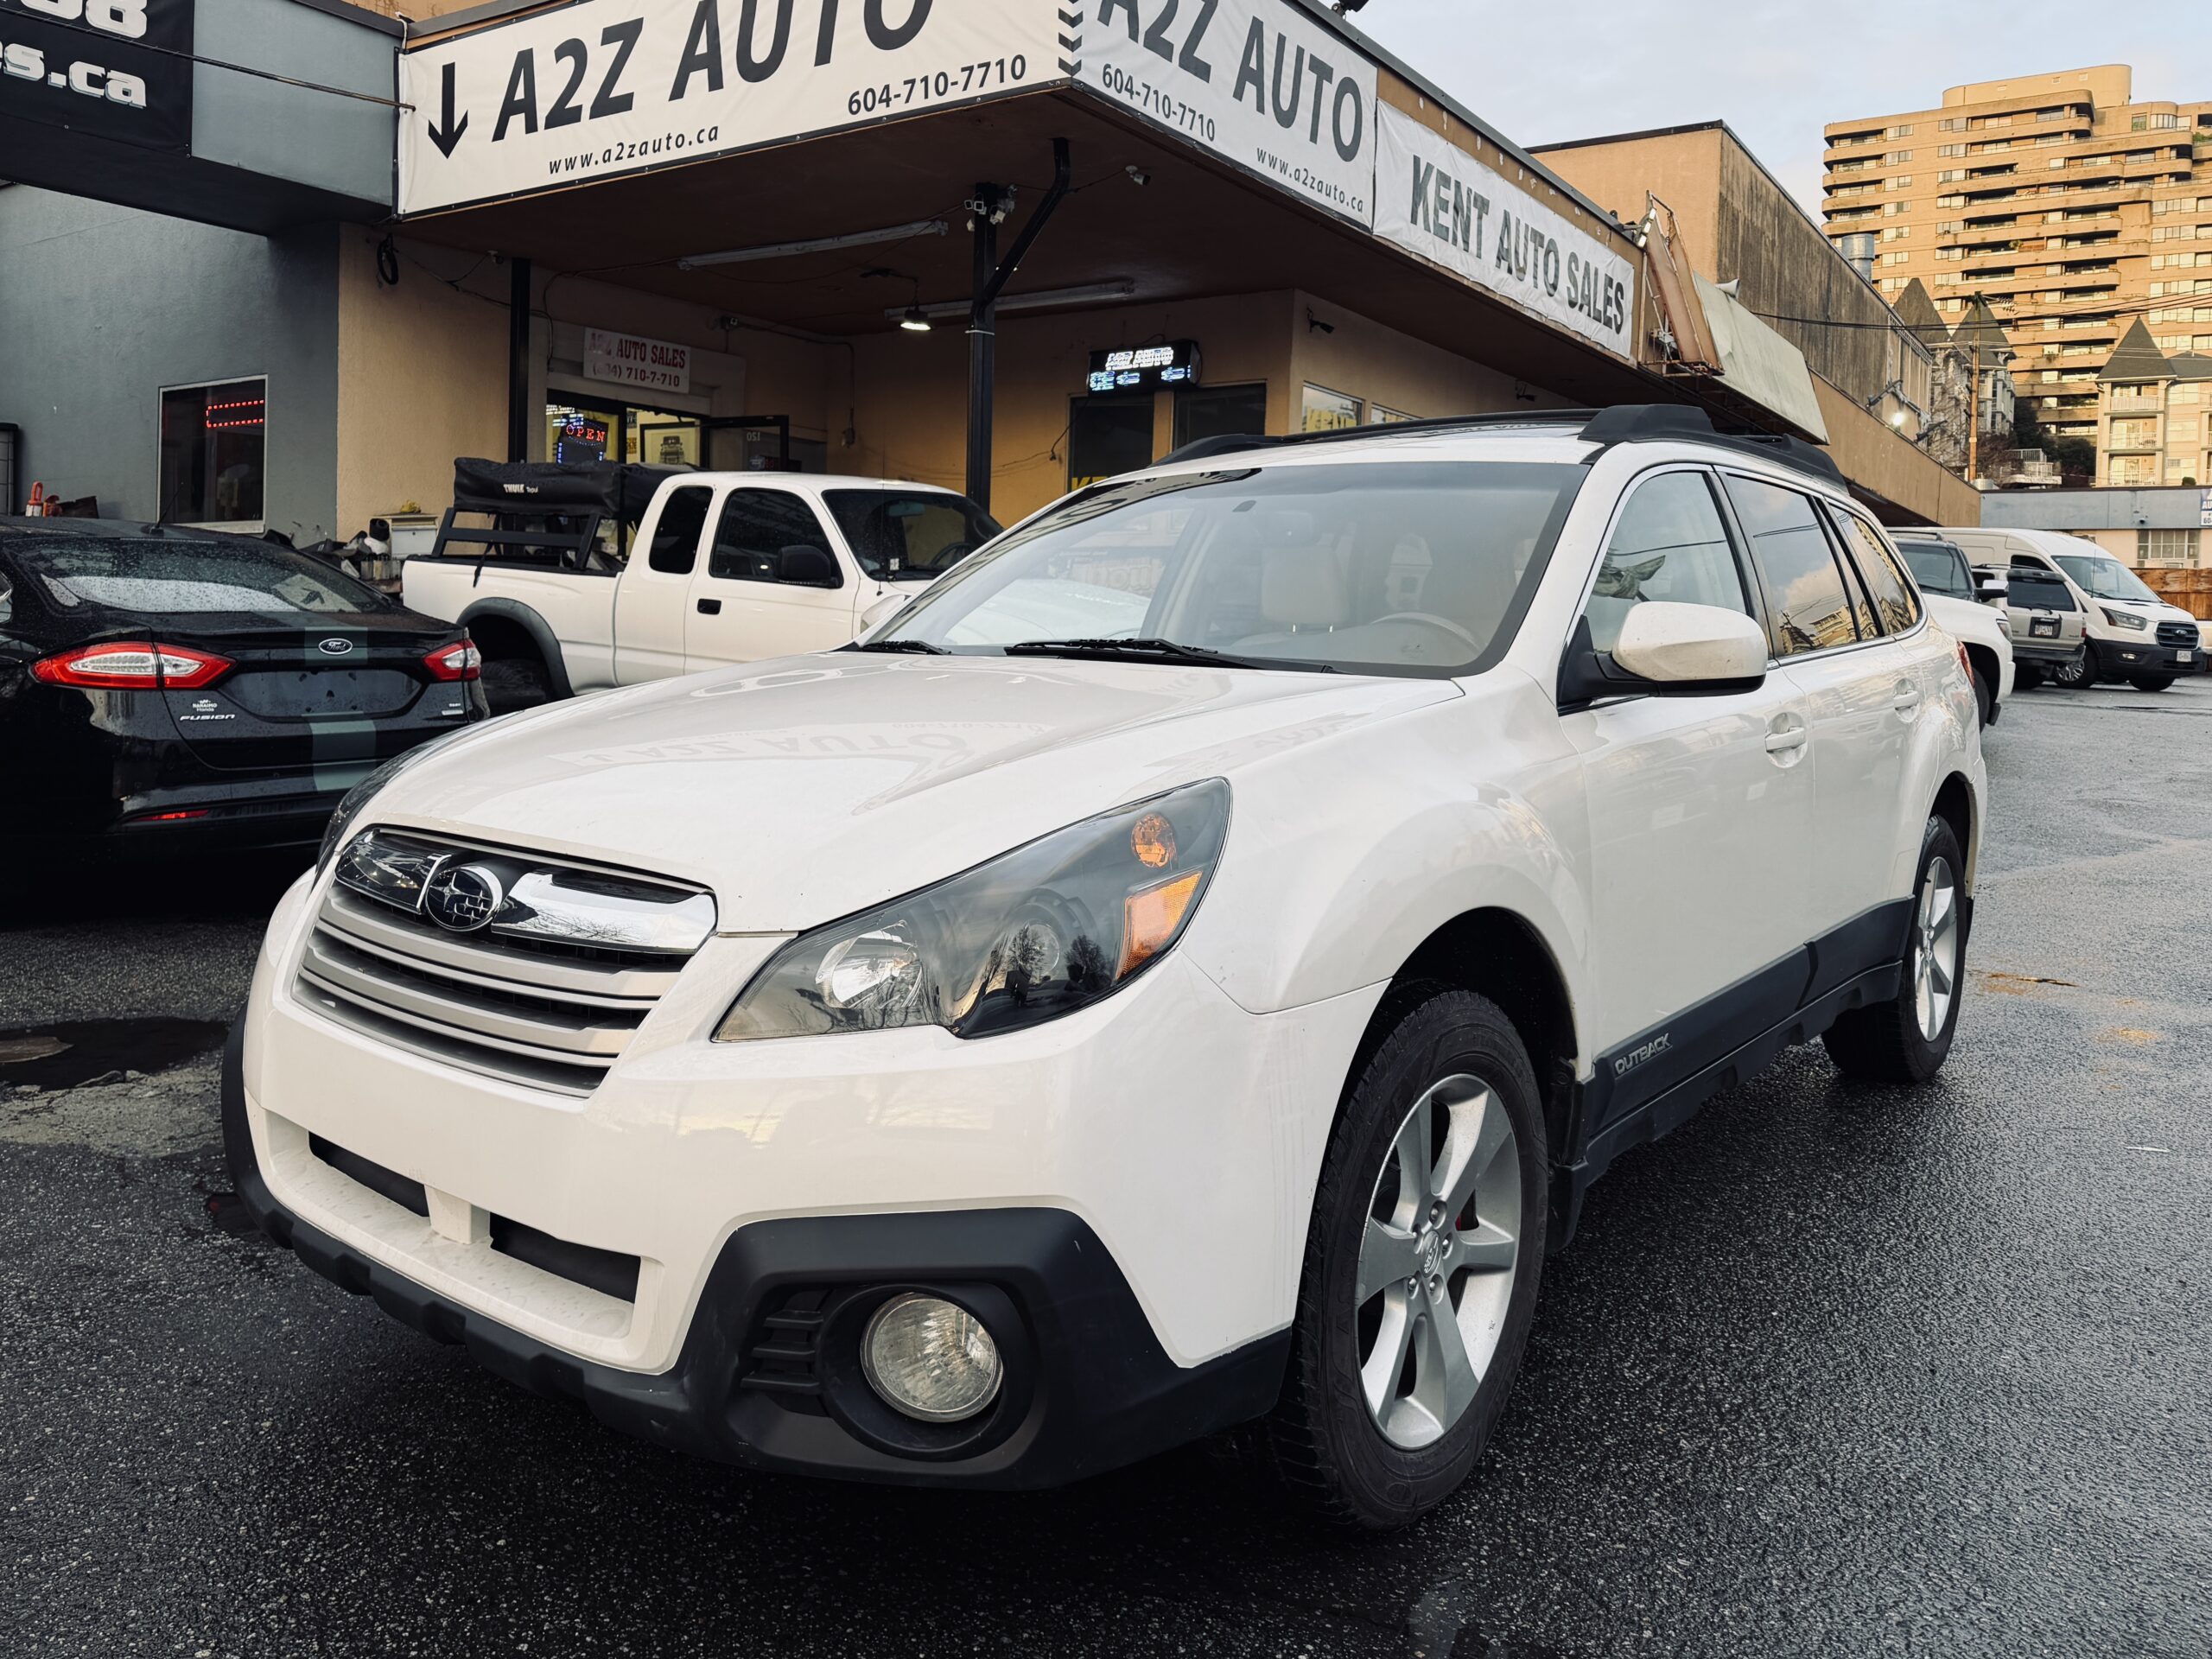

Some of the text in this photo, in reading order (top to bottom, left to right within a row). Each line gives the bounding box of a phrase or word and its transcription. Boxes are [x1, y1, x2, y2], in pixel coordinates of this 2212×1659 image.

[0, 41, 147, 109] s.ca
[492, 17, 645, 143] A2Z
[847, 54, 1027, 116] 604-710-7710
[1102, 63, 1216, 143] 604-710-7710
[1232, 15, 1363, 163] AUTO
[548, 124, 719, 175] www.a2zauto.ca
[1256, 147, 1364, 214] www.a2zauto.ca
[1409, 154, 1625, 335] KENT AUTO SALES
[616, 338, 647, 362] AUTO
[651, 344, 686, 370] SALES
[626, 366, 680, 387] 710-7-710
[566, 424, 606, 442] OPEN
[503, 483, 524, 493] THULE
[1615, 1033, 1671, 1075] OUTBACK
